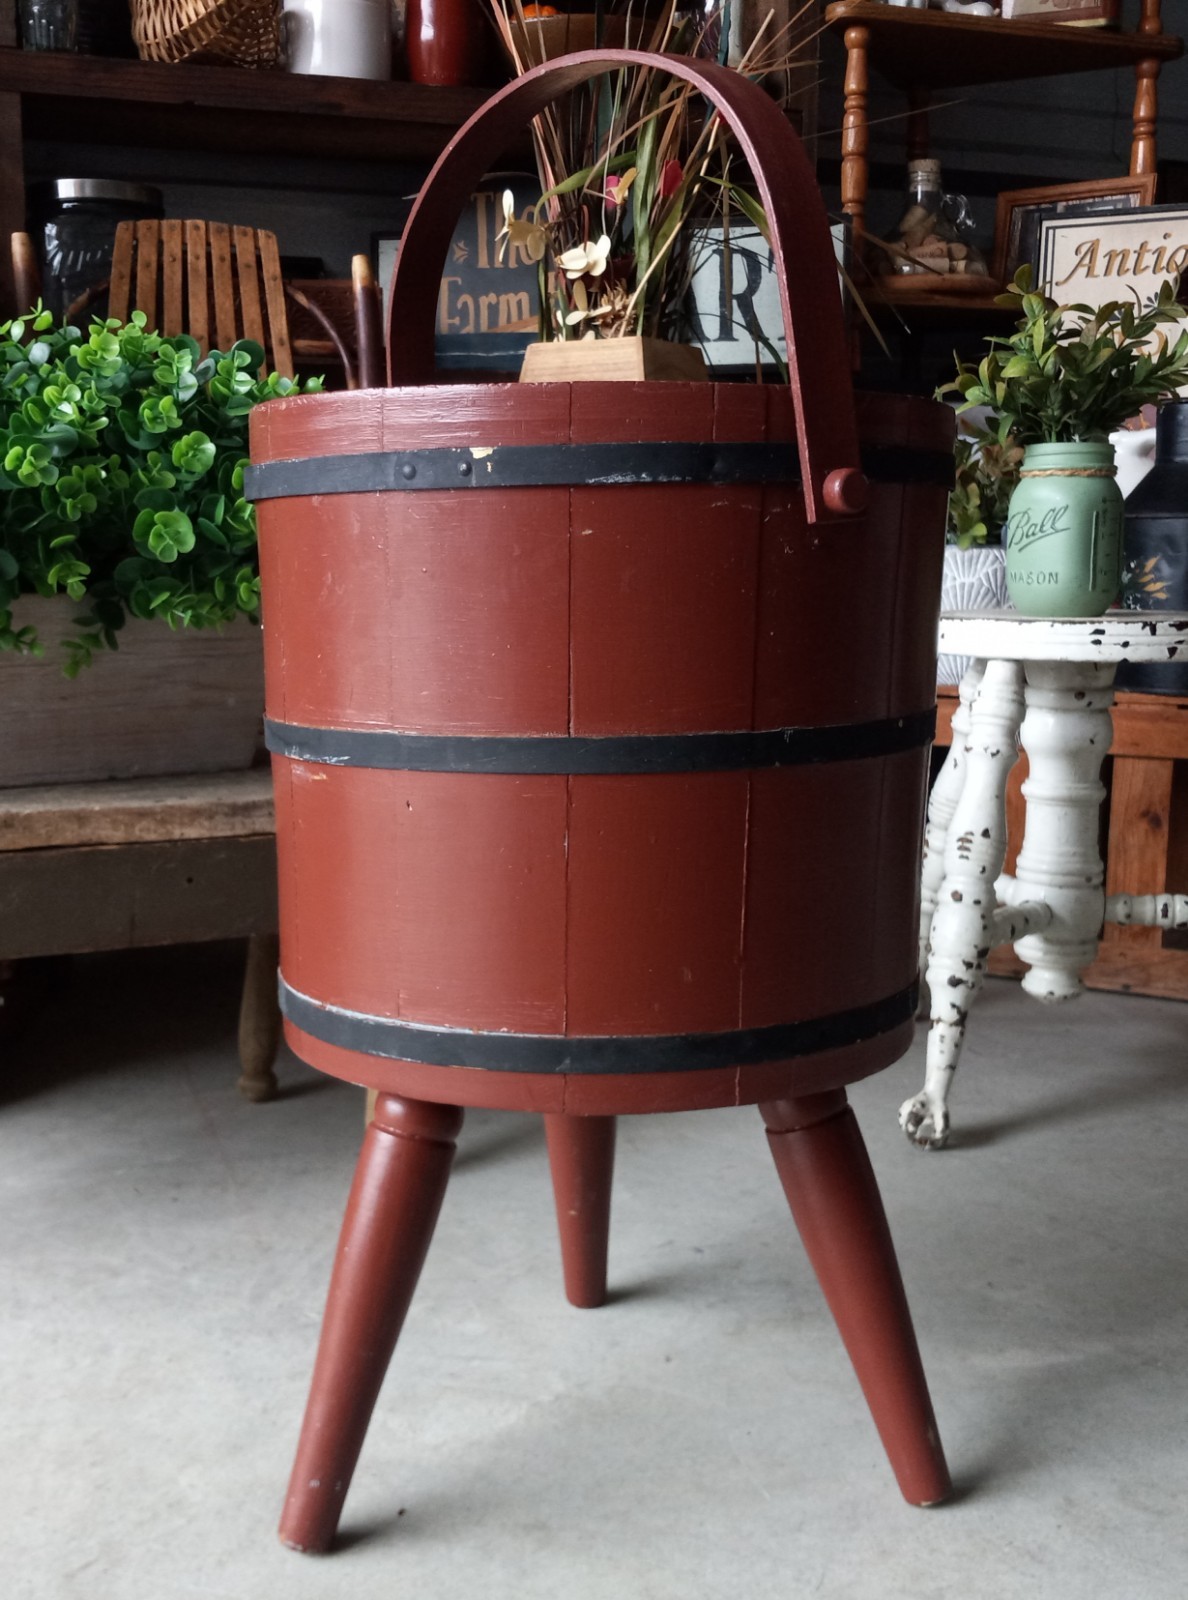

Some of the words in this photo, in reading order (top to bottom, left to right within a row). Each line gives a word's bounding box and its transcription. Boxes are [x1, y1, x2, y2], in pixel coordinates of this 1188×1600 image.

[439, 277, 530, 334] Farm
[1007, 504, 1070, 550] Ball
[1010, 571, 1059, 585] MASON
